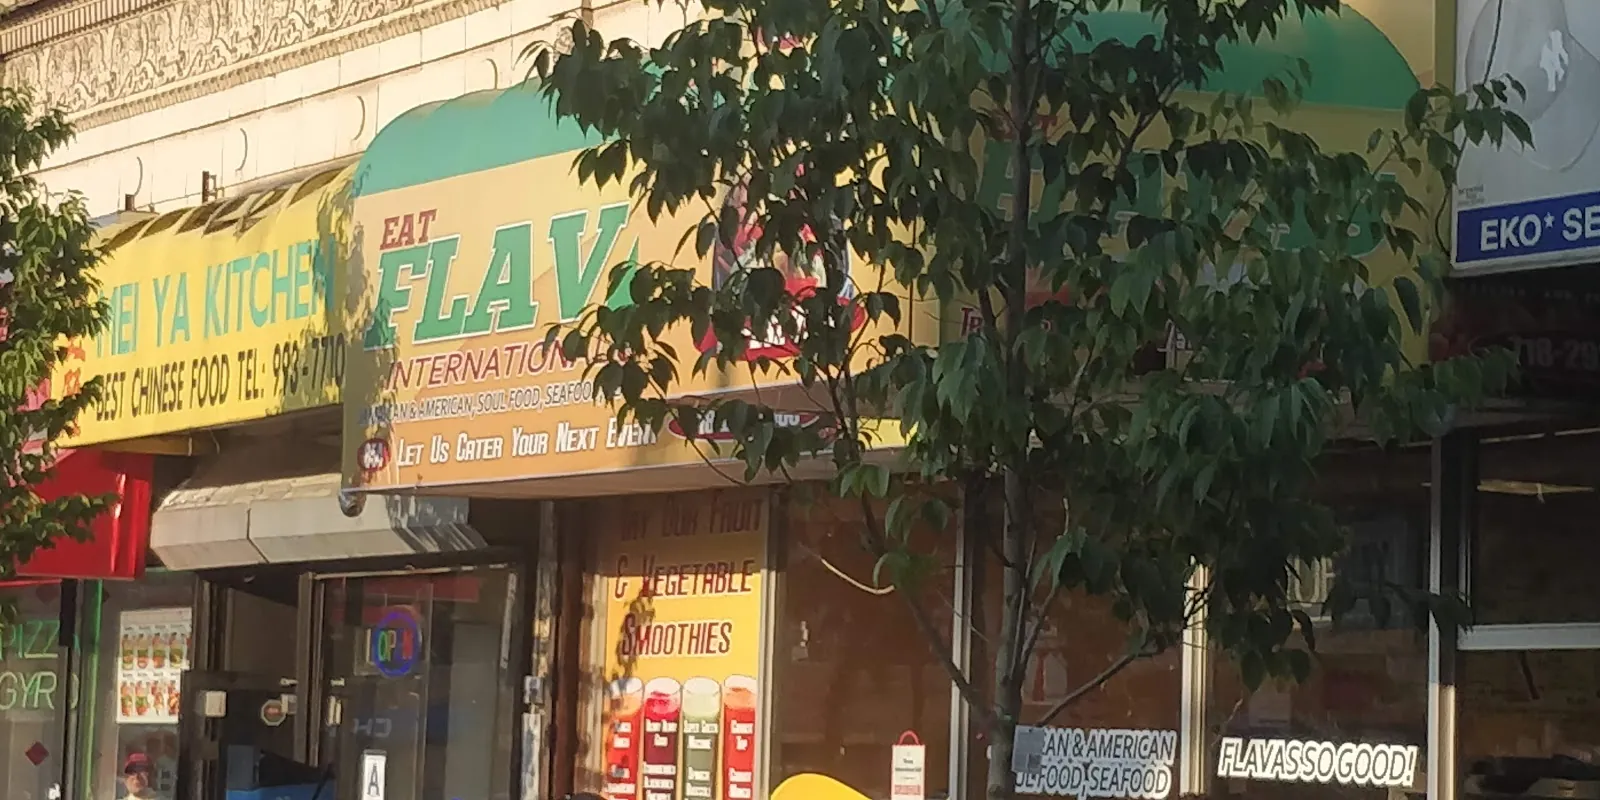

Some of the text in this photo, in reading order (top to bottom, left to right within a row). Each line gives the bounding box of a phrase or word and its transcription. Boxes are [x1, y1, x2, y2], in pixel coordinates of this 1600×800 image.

[380, 209, 437, 250] EAT
[1480, 213, 1542, 251] EKO
[97, 236, 336, 358] MEI YA KITCHEN
[364, 203, 640, 351] FLAV
[97, 371, 126, 422] BEST
[131, 361, 185, 417] CHINESE
[190, 353, 230, 409] FOOD
[238, 348, 265, 401] TEL:
[477, 392, 506, 412] SOUL
[545, 381, 596, 406] SEAFOO
[398, 437, 424, 466] LET
[430, 434, 449, 463] US
[457, 432, 503, 462] CATER
[512, 427, 548, 457] YOUR
[556, 421, 599, 453] NEXT
[710, 489, 763, 533] FRUIT
[642, 554, 754, 598] VEGETABLE
[0, 618, 60, 660] PIZZ
[622, 613, 733, 655] SMOOTHIES
[1086, 734, 1174, 760] AMERICAN
[1338, 747, 1417, 783] GOOD!
[367, 762, 380, 797] A
[1090, 766, 1169, 793] SEAFOOD
